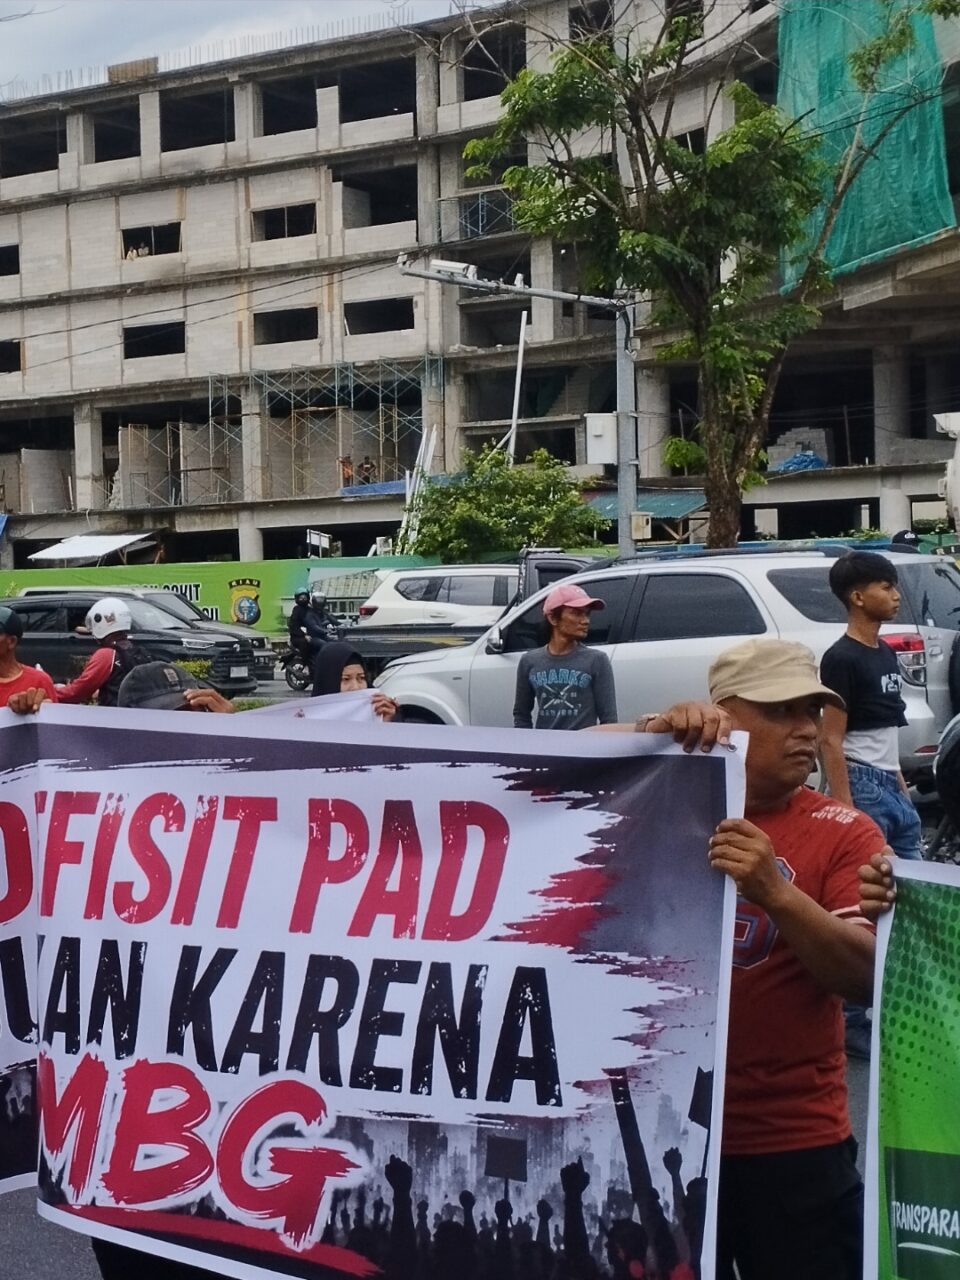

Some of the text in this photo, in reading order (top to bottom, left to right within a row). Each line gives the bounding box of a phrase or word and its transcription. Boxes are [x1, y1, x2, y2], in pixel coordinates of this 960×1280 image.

[231, 579, 259, 587] RIAU
[288, 798, 511, 943] PAD
[166, 944, 561, 1106] KARENA
[38, 1050, 362, 1252] MBG
